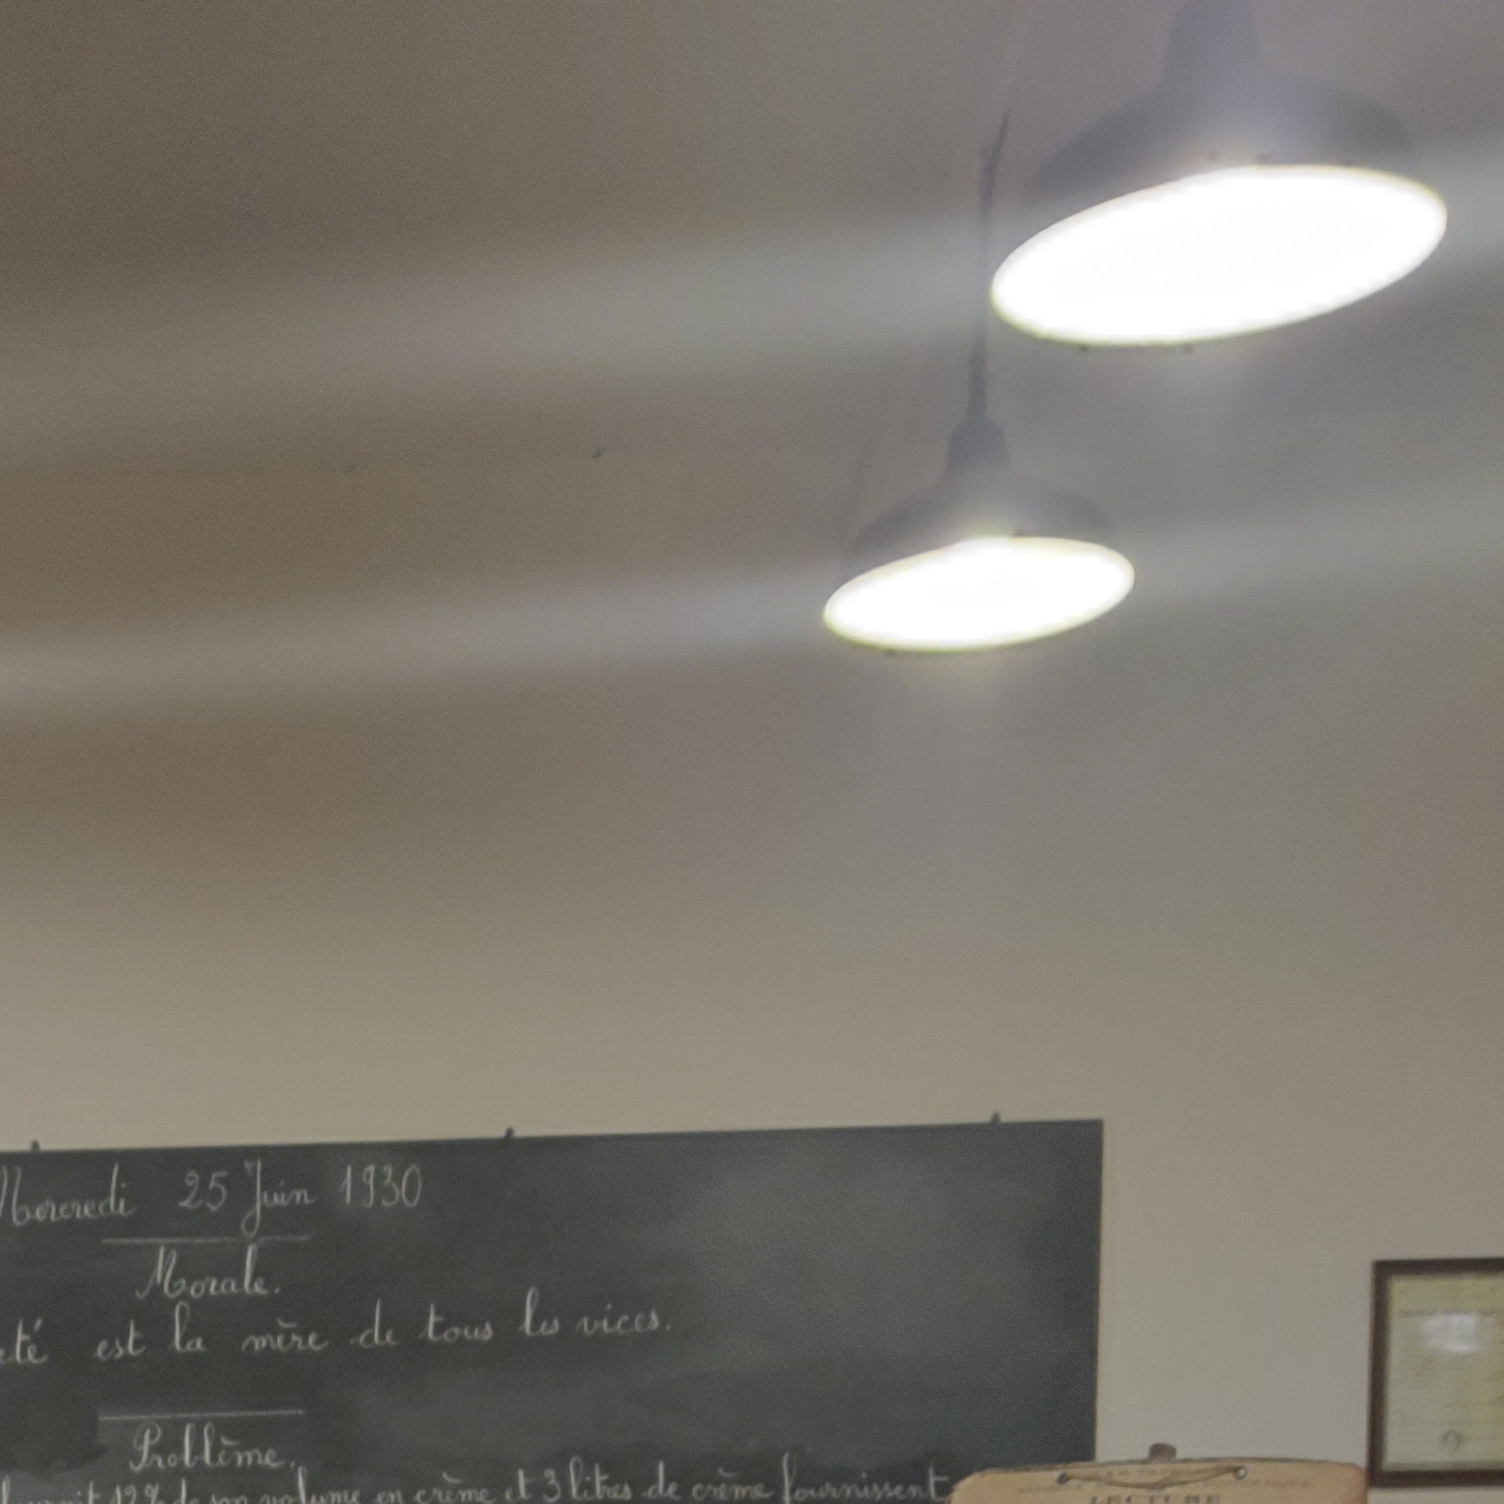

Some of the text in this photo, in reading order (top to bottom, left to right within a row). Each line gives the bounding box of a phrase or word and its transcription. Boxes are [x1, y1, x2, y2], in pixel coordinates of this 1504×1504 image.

[178, 1168, 228, 1212] 25
[241, 1159, 315, 1240] Juin
[339, 1163, 423, 1208] 1930
[92, 1318, 147, 1362] est
[174, 1300, 206, 1354] la
[350, 1299, 400, 1346] de
[421, 1303, 493, 1341] tous
[517, 1286, 560, 1337] les
[503, 1467, 533, 1501] et
[543, 1469, 563, 1502] 3
[566, 1454, 633, 1502] litres
[642, 1460, 683, 1502] de
